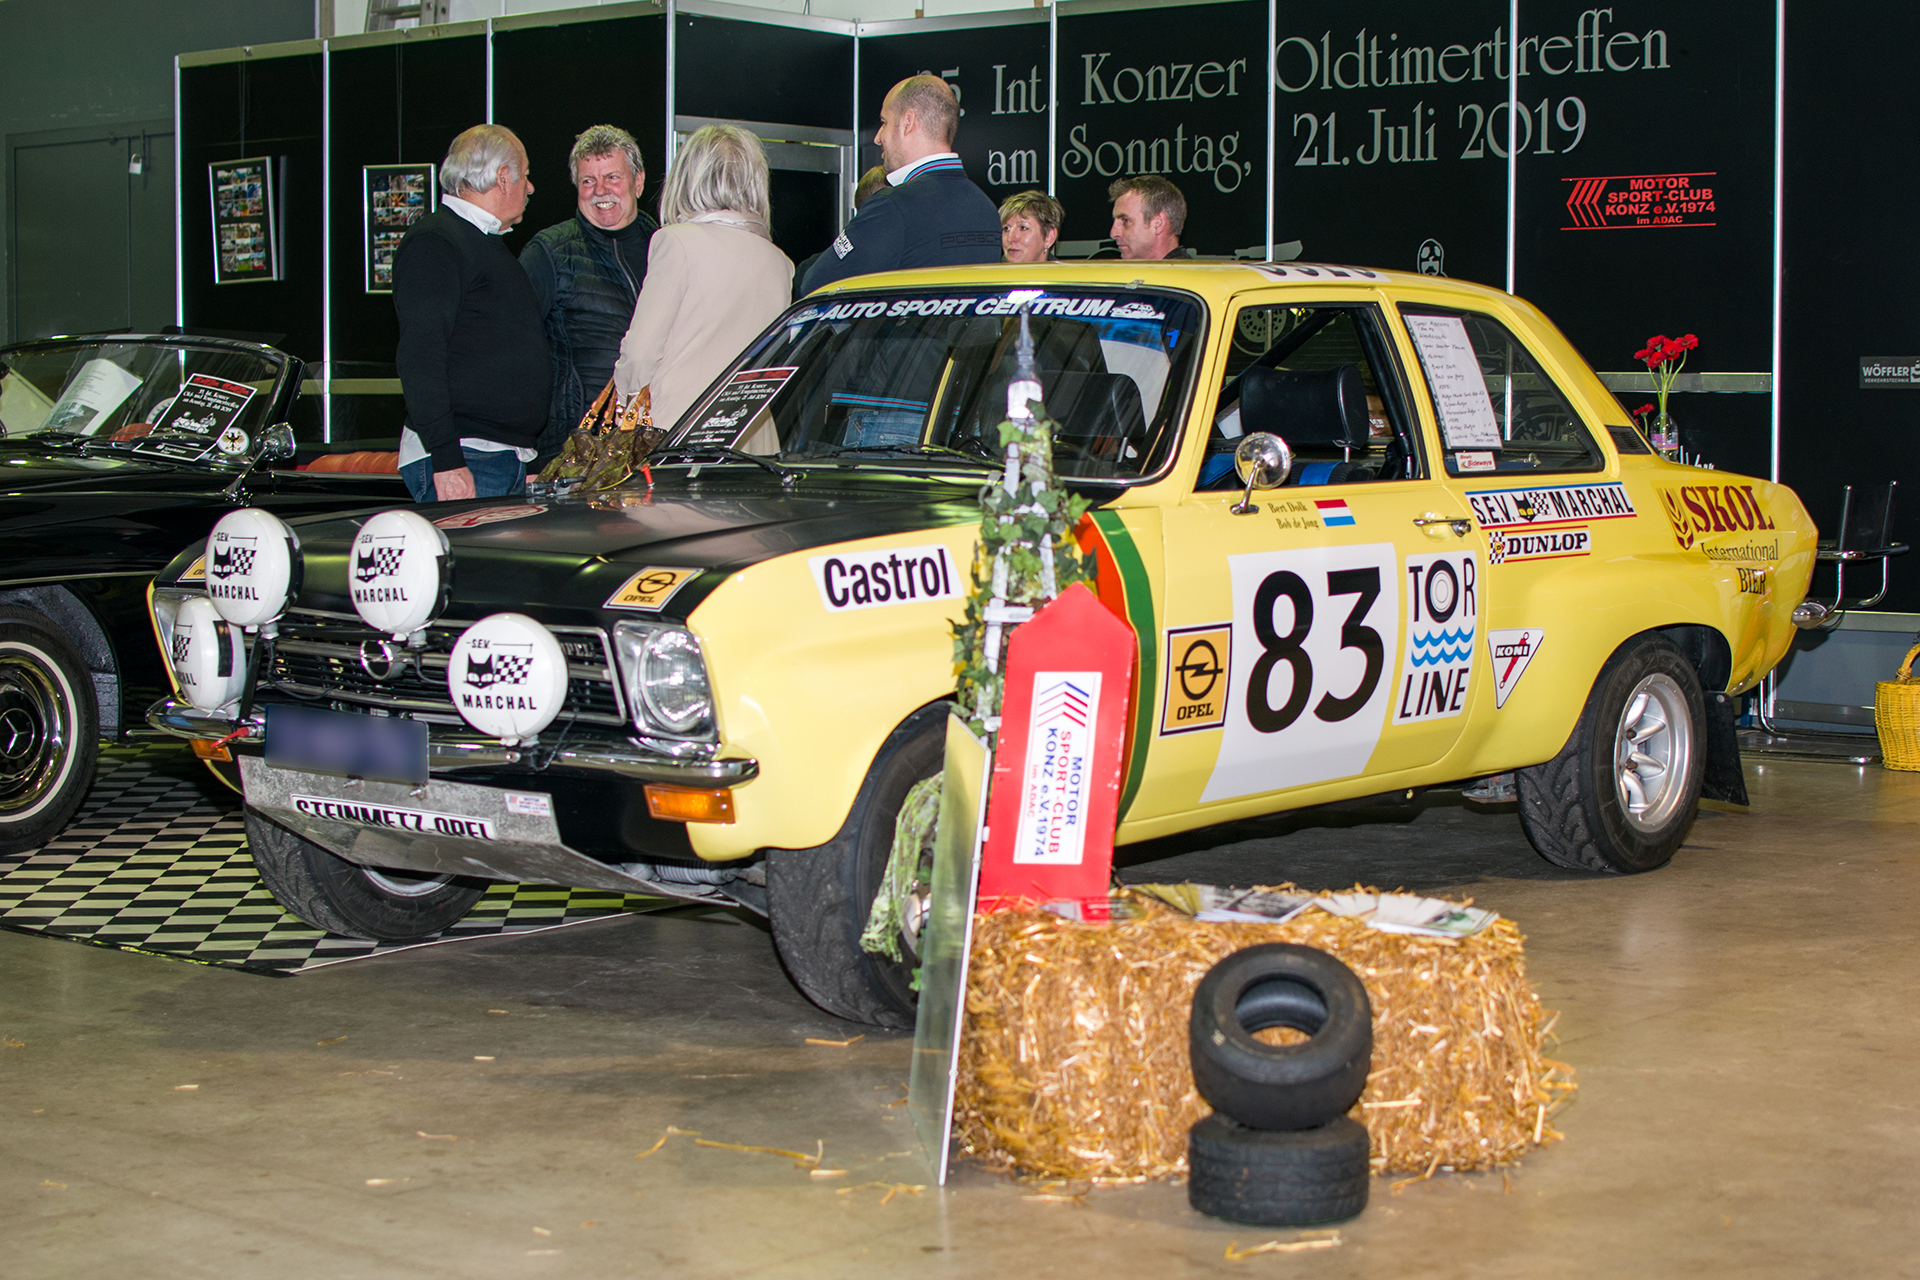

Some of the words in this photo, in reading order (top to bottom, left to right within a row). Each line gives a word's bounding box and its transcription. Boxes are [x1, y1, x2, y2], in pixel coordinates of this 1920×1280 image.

[1081, 53, 1247, 105] Konzer
[1274, 8, 1671, 93] Oldtimertreffen
[987, 149, 1040, 186] am
[1062, 123, 1251, 193] Sonntag,
[1457, 96, 1587, 160] 2019
[1629, 177, 1690, 190] MOTOR
[1608, 188, 1714, 203] SPORT-CLUB
[1605, 203, 1650, 216] KONZ
[1636, 217, 1650, 225] im
[1653, 215, 1684, 224] ADAC
[941, 234, 1001, 247] PORSCH
[821, 302, 888, 321] AUTO
[886, 299, 977, 317] SPORT
[1862, 363, 1910, 377] WÖFFLER
[1267, 502, 1288, 514] Bert
[1470, 494, 1516, 525] S.E.V.
[1548, 487, 1635, 518] MARCHAL
[1681, 485, 1775, 533] SKOL
[1276, 518, 1292, 530] Bob
[1292, 517, 1301, 528] de
[1301, 517, 1320, 531] Jong
[1506, 532, 1588, 556] DUNLOP
[1699, 538, 1779, 562] International
[823, 548, 951, 608] Castrol
[1736, 567, 1767, 596] BIER
[210, 584, 259, 601] MARCHAL
[354, 587, 408, 604] MARCHAL
[623, 594, 656, 603] OPEL
[1408, 557, 1476, 624] TOR
[1245, 566, 1385, 734] 83
[1496, 645, 1528, 657] KONI
[462, 694, 537, 710] MARCHAL
[1398, 667, 1470, 719] LINE
[1176, 703, 1214, 720] OPEL
[1042, 727, 1058, 778] KONZ
[1027, 784, 1038, 818] ADAC
[1048, 730, 1072, 854] SPORT-CLUB
[1065, 756, 1083, 826] MOTOR
